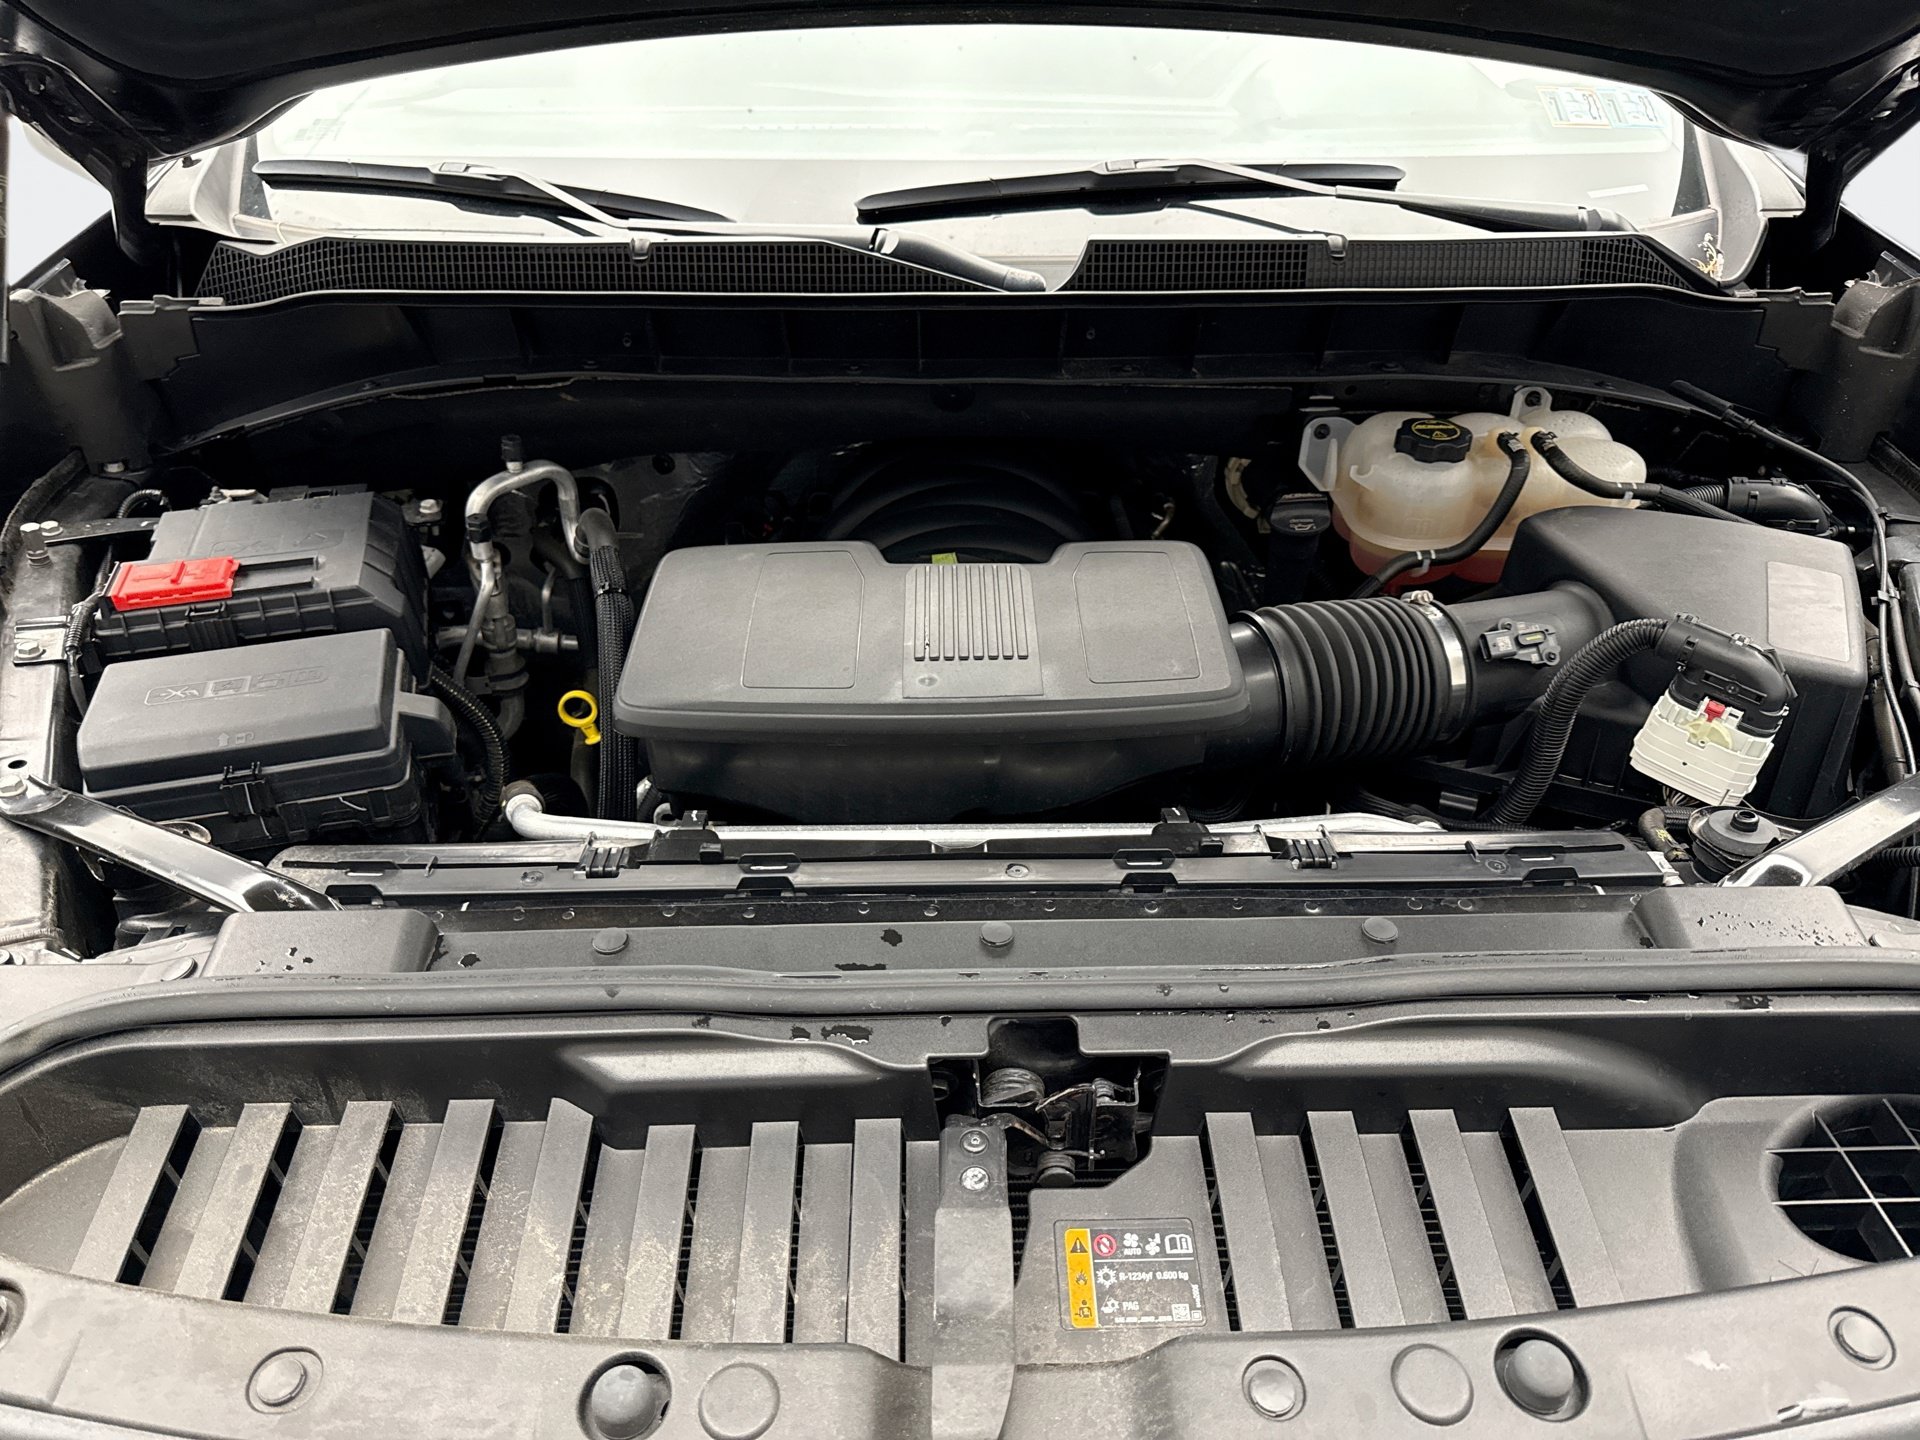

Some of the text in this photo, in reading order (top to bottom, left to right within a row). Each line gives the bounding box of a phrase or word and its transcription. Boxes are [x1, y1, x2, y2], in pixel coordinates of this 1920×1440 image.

[1123, 1247, 1142, 1255] AUTO
[1119, 1271, 1153, 1282] R-1234yf
[1178, 1270, 1189, 1281] kg
[1122, 1301, 1139, 1311] PAG
